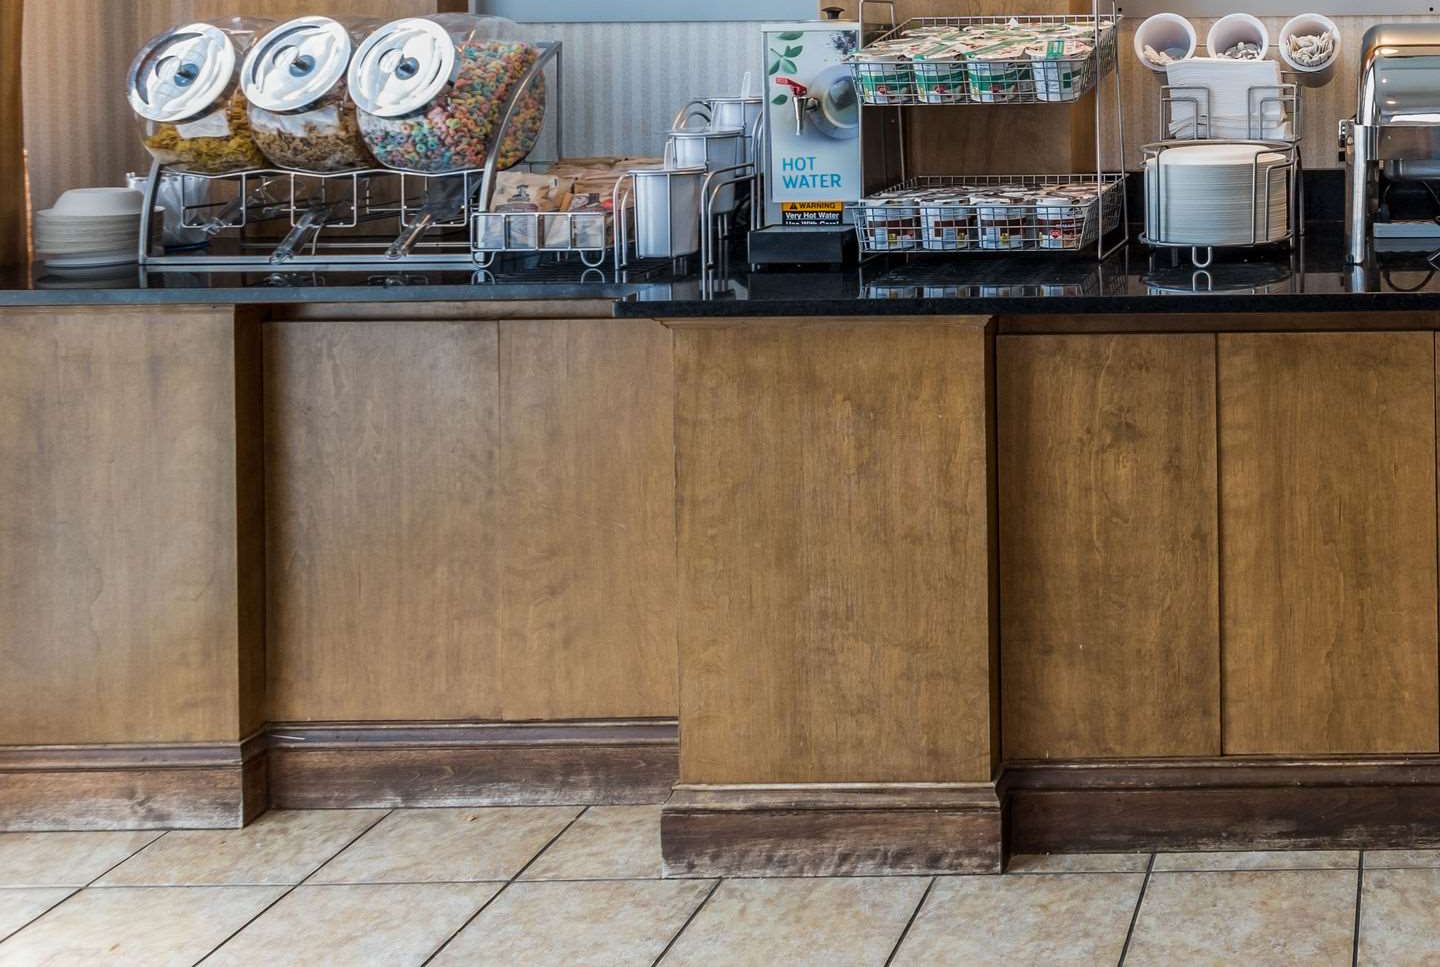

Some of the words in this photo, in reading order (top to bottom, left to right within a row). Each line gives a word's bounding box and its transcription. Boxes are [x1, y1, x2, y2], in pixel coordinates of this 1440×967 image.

[783, 156, 816, 171] HOT
[783, 174, 842, 189] WATER
[799, 201, 836, 209] WARNING
[785, 212, 802, 220] Very
